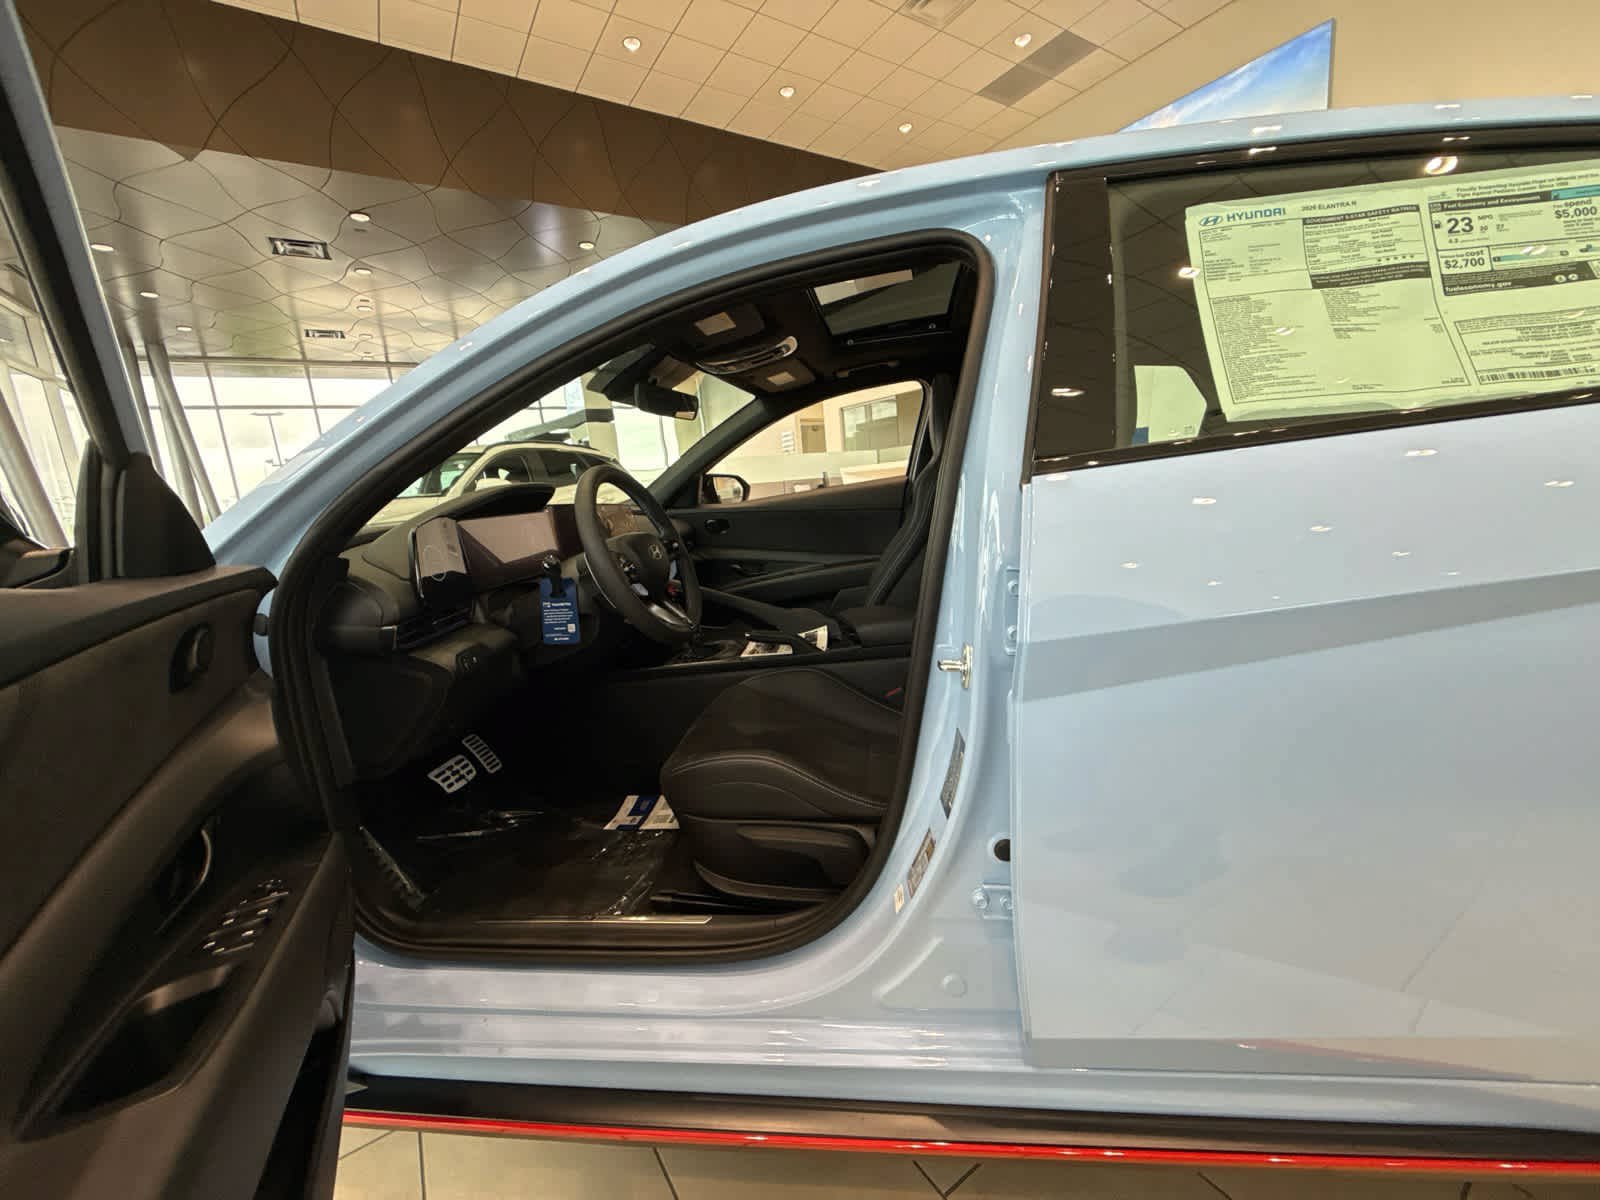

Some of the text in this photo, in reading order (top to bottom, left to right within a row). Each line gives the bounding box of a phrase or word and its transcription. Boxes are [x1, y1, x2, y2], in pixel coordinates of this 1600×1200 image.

[1318, 201, 1350, 210] ELANTRA
[1564, 198, 1592, 208] spend
[1226, 207, 1287, 222] HYUNDAI
[1554, 206, 1598, 219] $5,000
[1446, 216, 1474, 234] 23
[1444, 256, 1485, 270] $2,700
